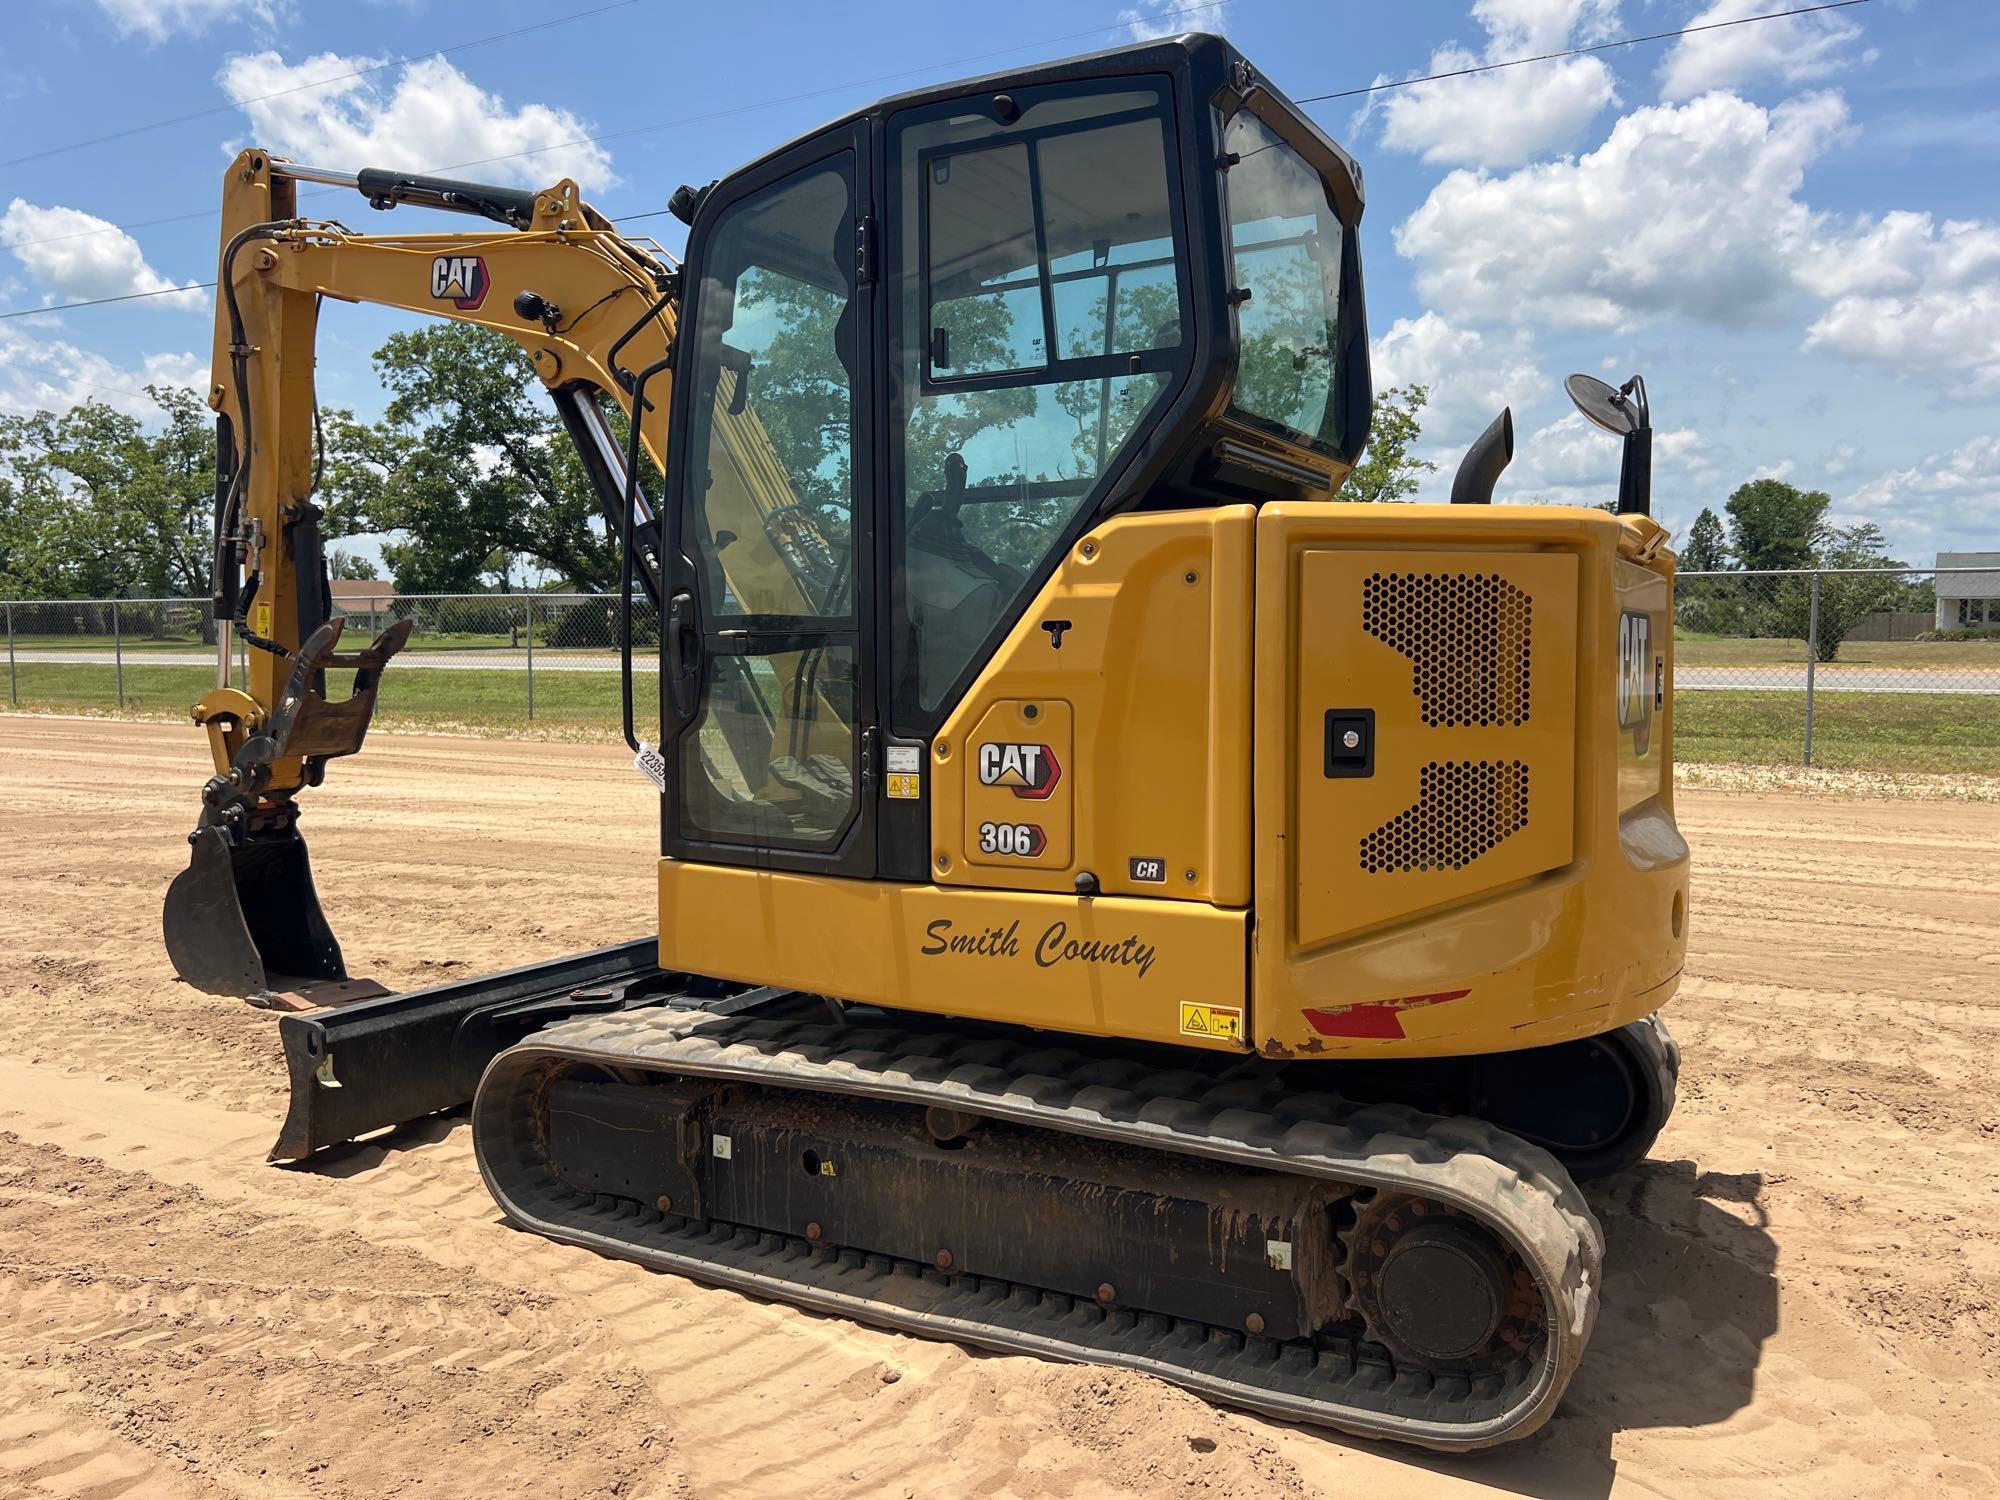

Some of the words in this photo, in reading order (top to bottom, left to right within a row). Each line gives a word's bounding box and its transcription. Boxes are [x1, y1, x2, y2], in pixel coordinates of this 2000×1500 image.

[432, 257, 477, 298] CAT
[1619, 613, 1648, 726] CAT
[980, 743, 1041, 787] CAT
[980, 823, 1031, 855] 306
[1136, 861, 1159, 878] CR
[921, 919, 1020, 957] Smith
[1034, 921, 1156, 978] County
